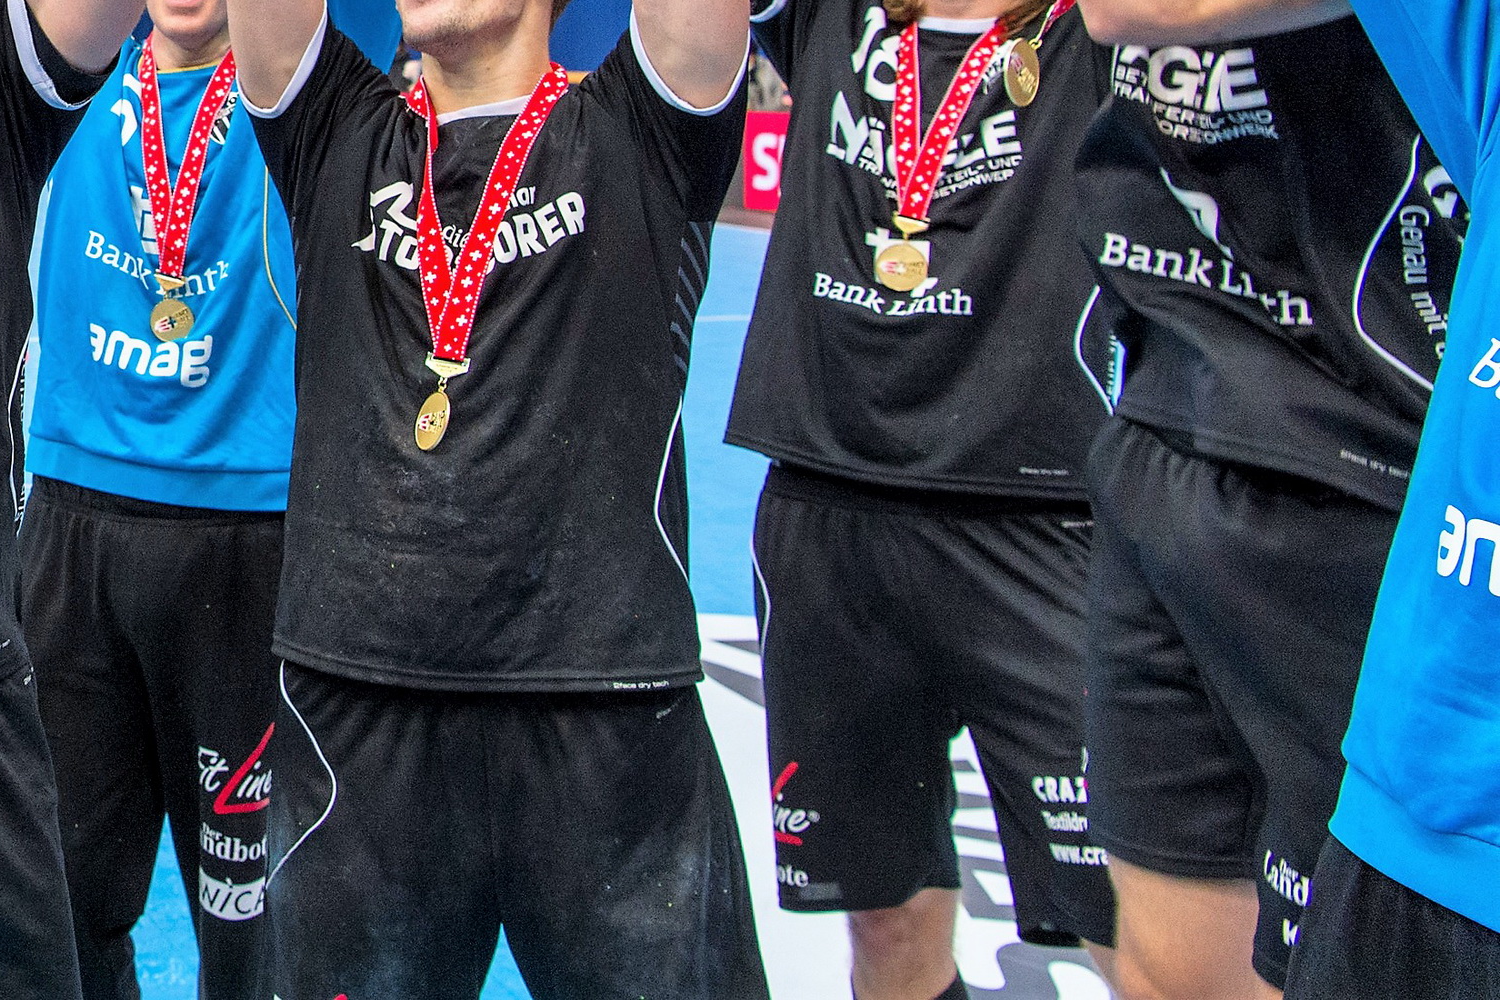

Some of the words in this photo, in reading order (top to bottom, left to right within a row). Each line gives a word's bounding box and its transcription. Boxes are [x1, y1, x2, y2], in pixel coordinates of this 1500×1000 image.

[84, 230, 152, 290] Bank
[1099, 232, 1213, 289] Bank
[812, 271, 887, 315] Bank
